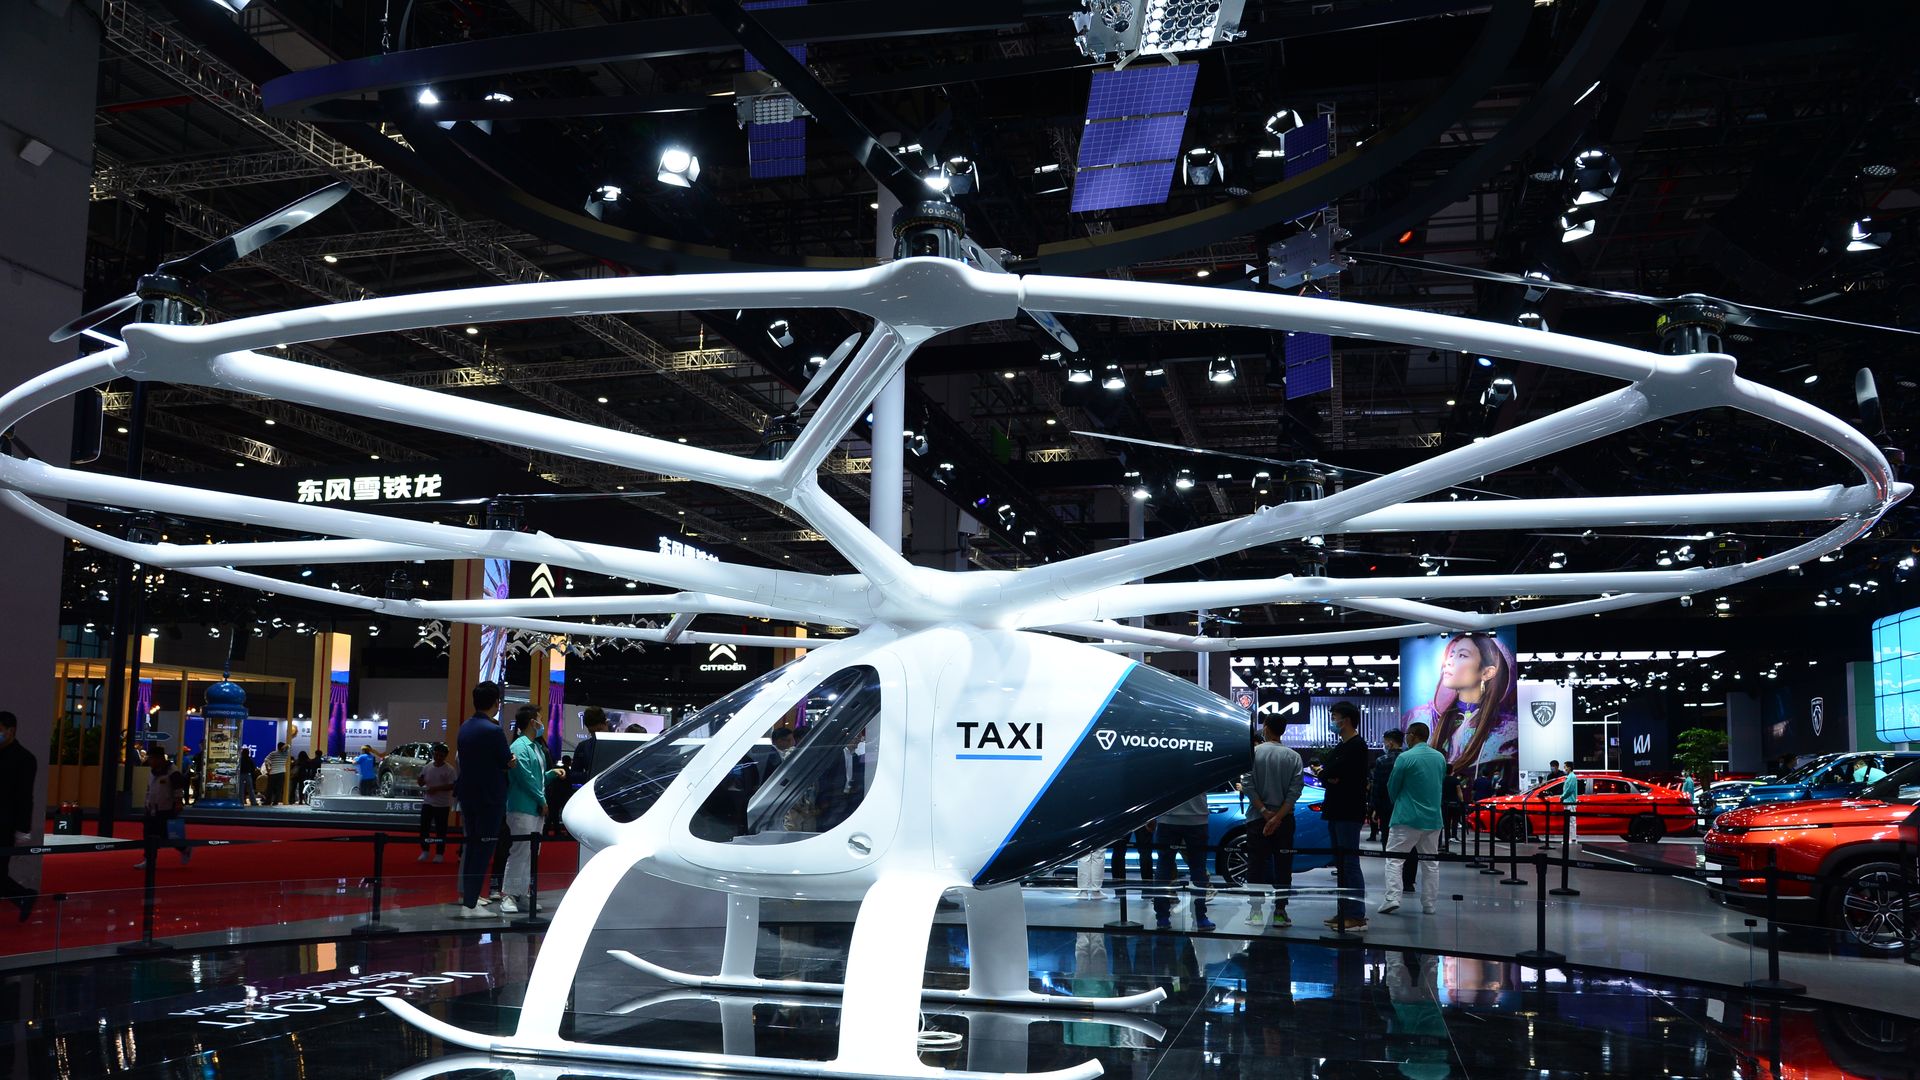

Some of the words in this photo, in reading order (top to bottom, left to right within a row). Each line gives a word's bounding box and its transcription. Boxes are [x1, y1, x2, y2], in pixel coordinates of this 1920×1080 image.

[297, 474, 442, 503] 东风雪铁龙
[957, 722, 1043, 750] TAXI
[1121, 735, 1214, 753] VOLOCOPTER
[197, 970, 490, 1030] VOLOPORT
